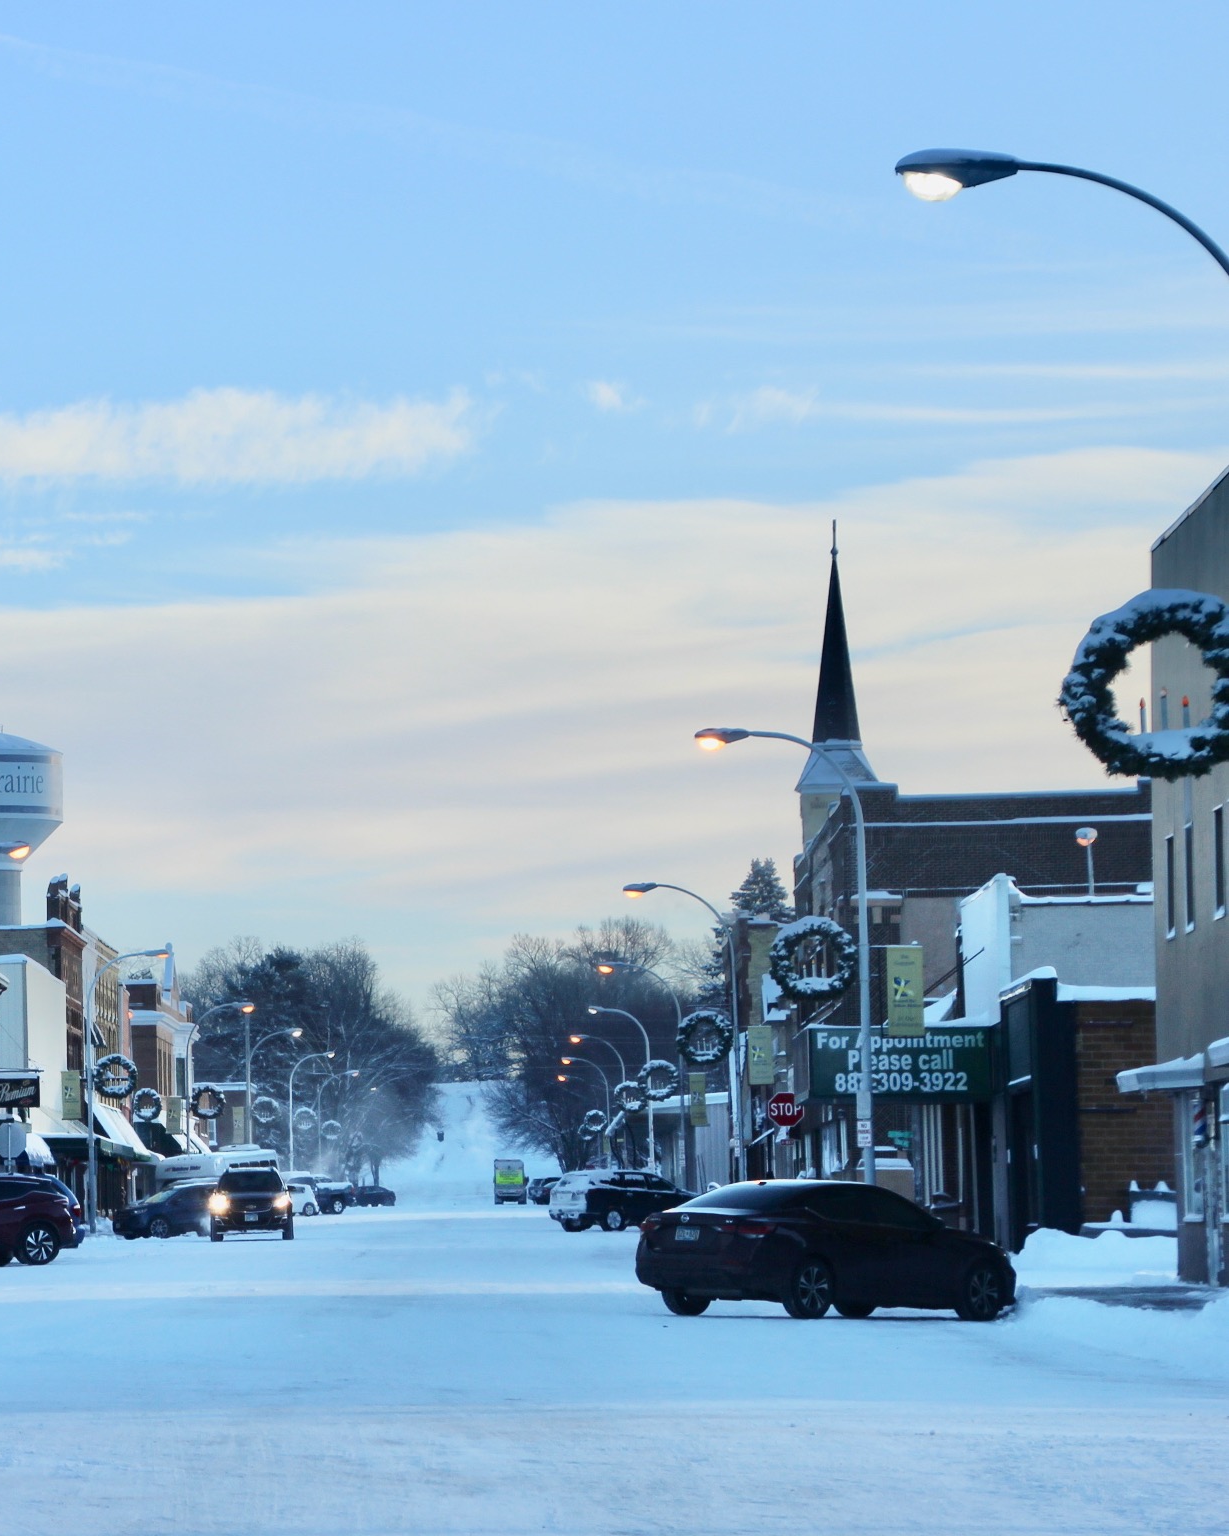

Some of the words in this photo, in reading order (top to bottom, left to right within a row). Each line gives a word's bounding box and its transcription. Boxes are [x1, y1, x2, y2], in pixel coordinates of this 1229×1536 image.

[816, 1032, 849, 1049] For
[918, 1049, 954, 1070] call
[770, 1102, 801, 1116] STOP
